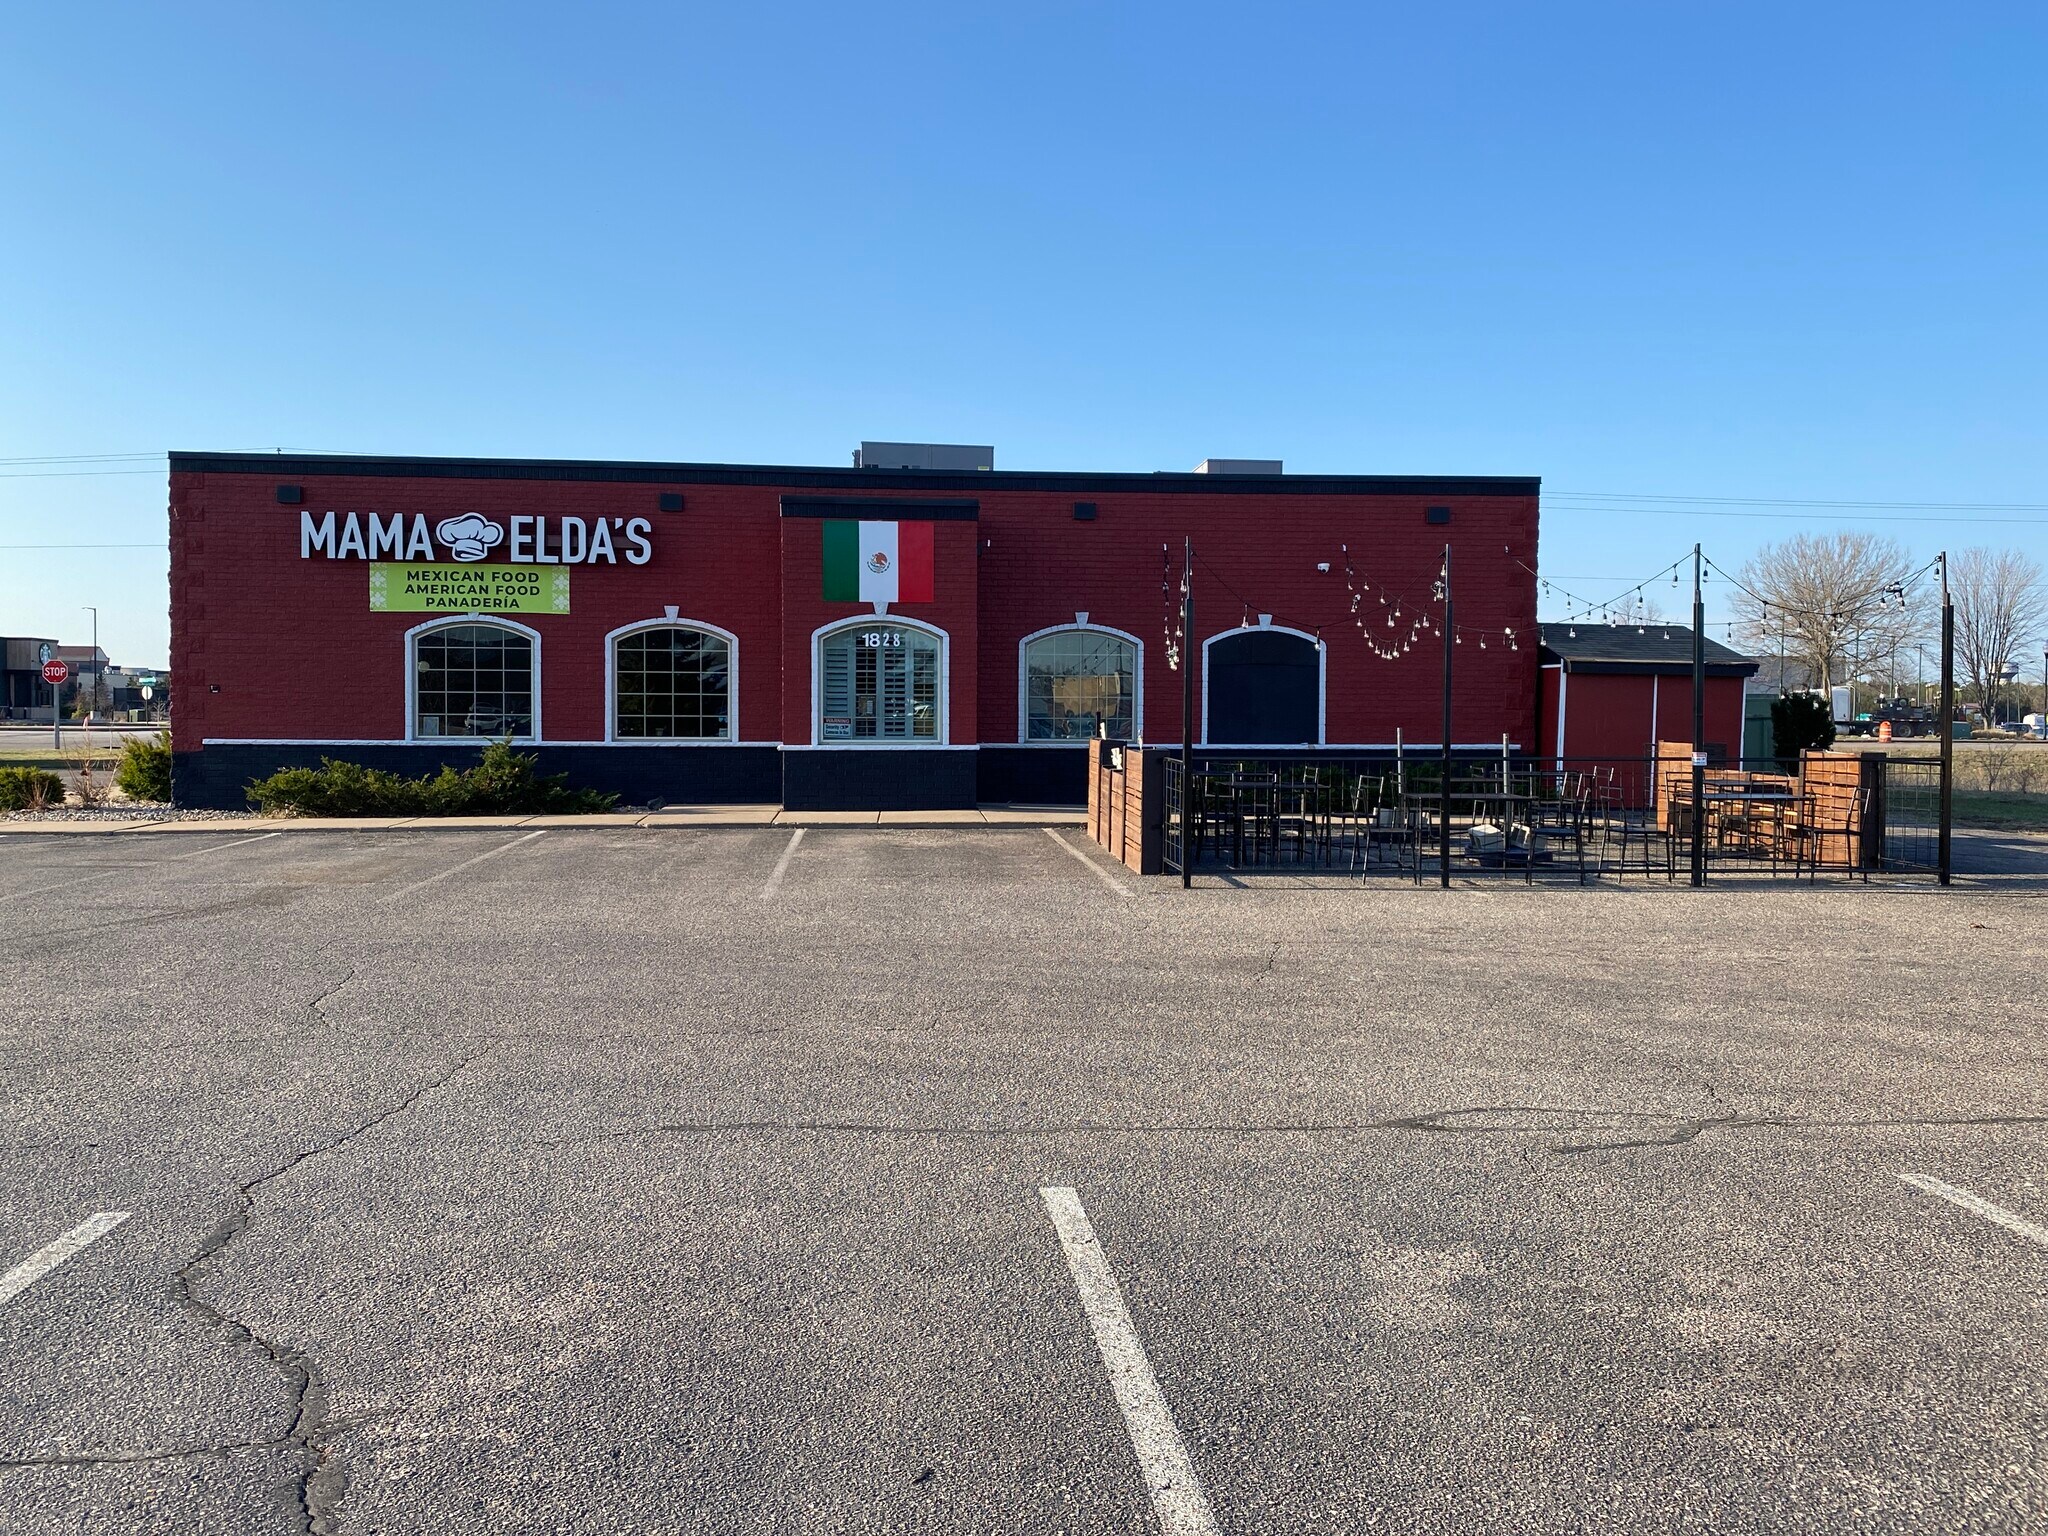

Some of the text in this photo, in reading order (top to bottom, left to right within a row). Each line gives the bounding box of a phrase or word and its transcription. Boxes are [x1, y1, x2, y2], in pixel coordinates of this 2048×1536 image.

[300, 511, 652, 565] MAMA ELDA'S
[407, 571, 539, 583] MEXICAN FOOD
[405, 584, 540, 595] AMERICAN FOOD
[426, 596, 519, 608] PANADERÍA
[861, 633, 900, 647] 1828
[44, 667, 65, 676] STOP
